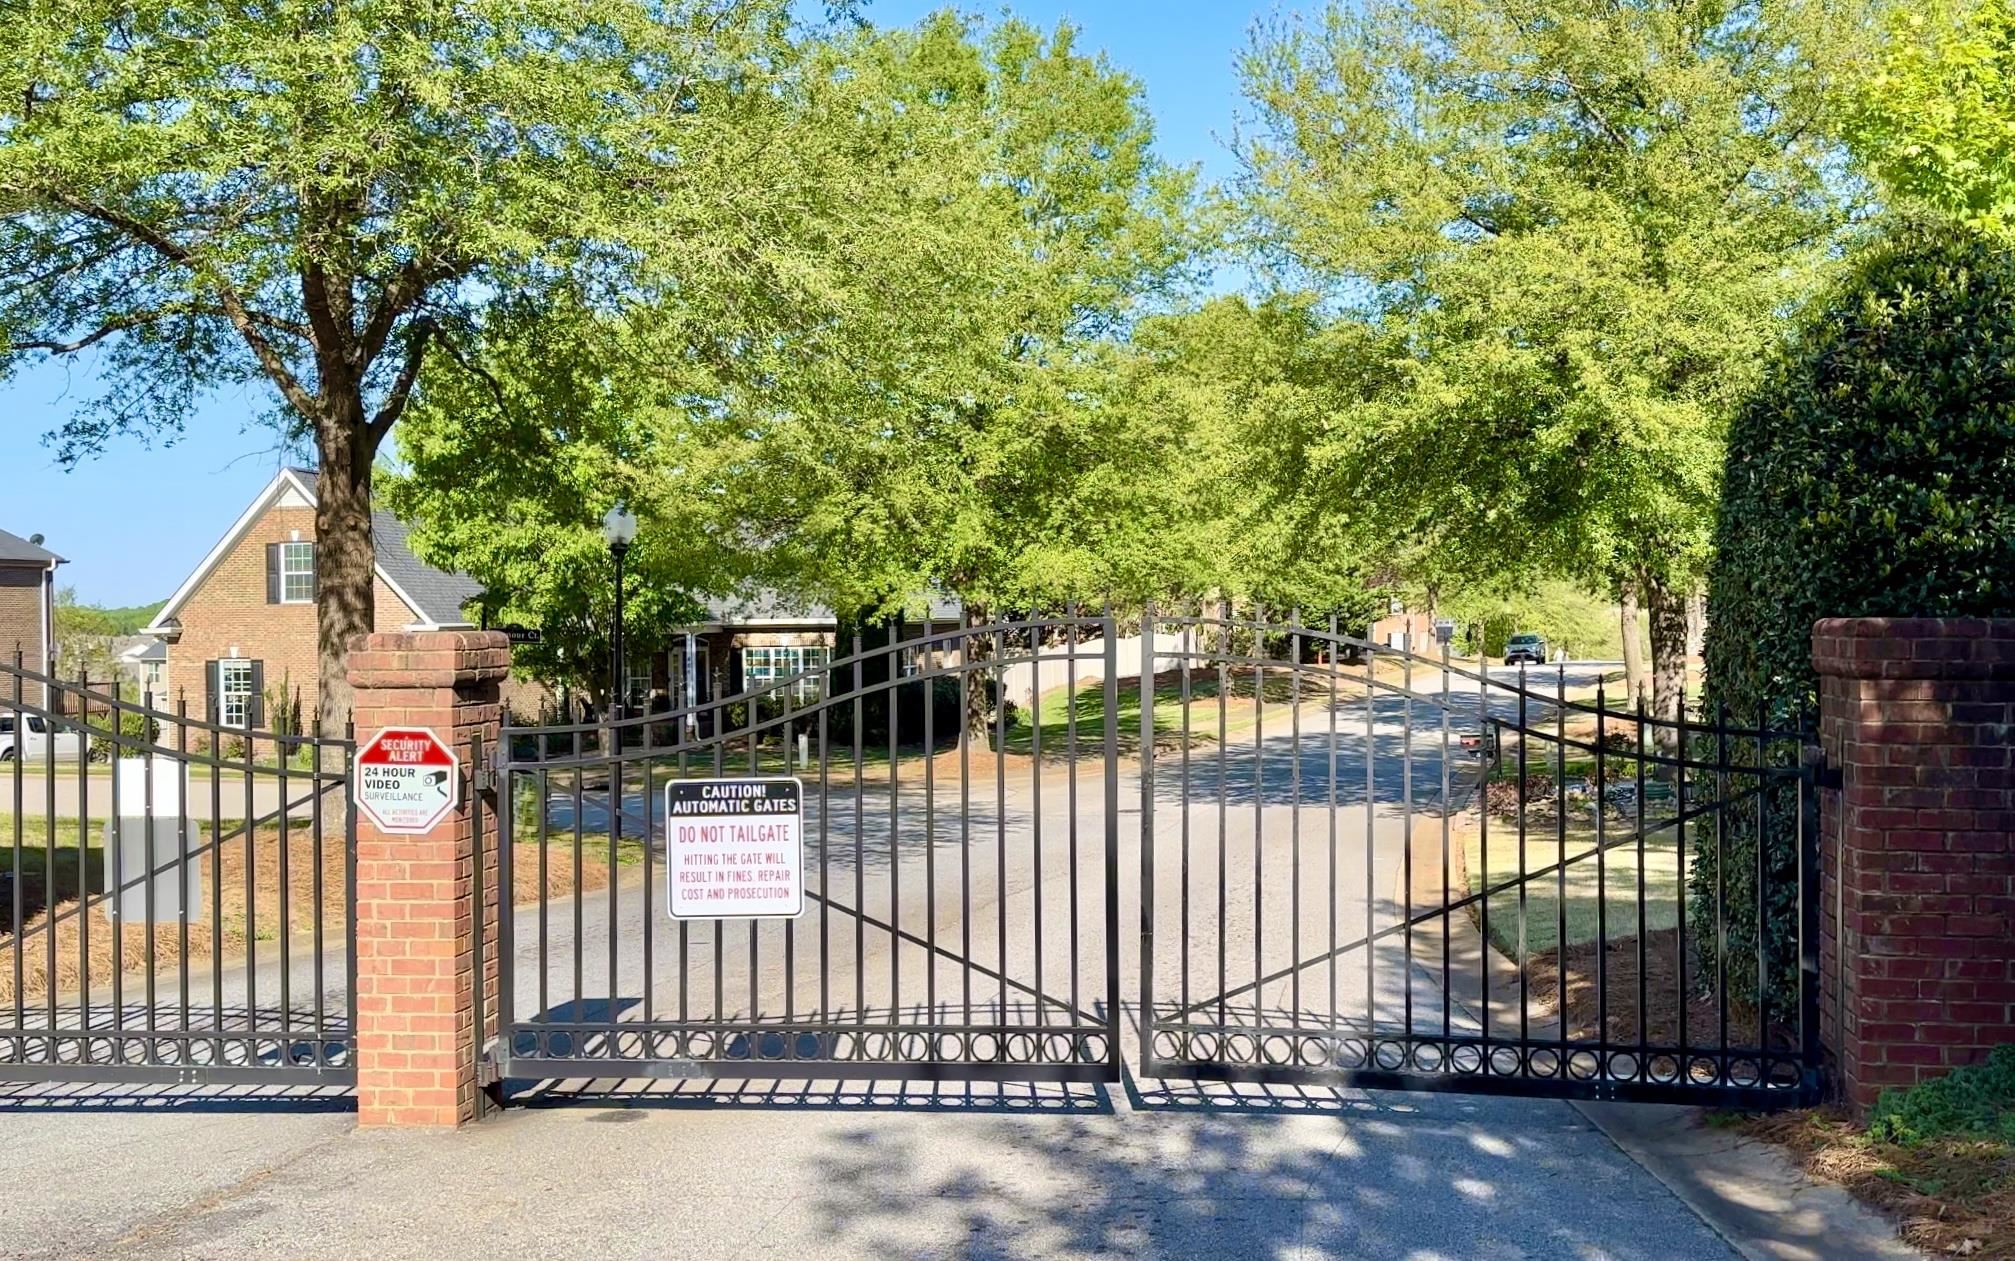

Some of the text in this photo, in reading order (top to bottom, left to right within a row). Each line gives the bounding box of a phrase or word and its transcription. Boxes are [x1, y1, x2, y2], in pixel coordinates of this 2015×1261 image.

[380, 739, 431, 751] SECURITY
[388, 751, 424, 762] ALERT
[364, 767, 415, 778] 24 HOUR
[365, 779, 400, 790] VIDEO
[364, 791, 423, 801] SURVEILLANCE
[702, 785, 767, 799] CAUTION!
[672, 799, 797, 814] AUTOMATIC GATES
[679, 824, 790, 843] DO NOT TAILGATE
[684, 852, 786, 865] HITTING THE GATE WILL
[680, 871, 712, 883] RESULT
[715, 870, 724, 882] IN
[758, 869, 791, 882] REPAIR
[681, 887, 790, 900] COST AND PROSECUTION
